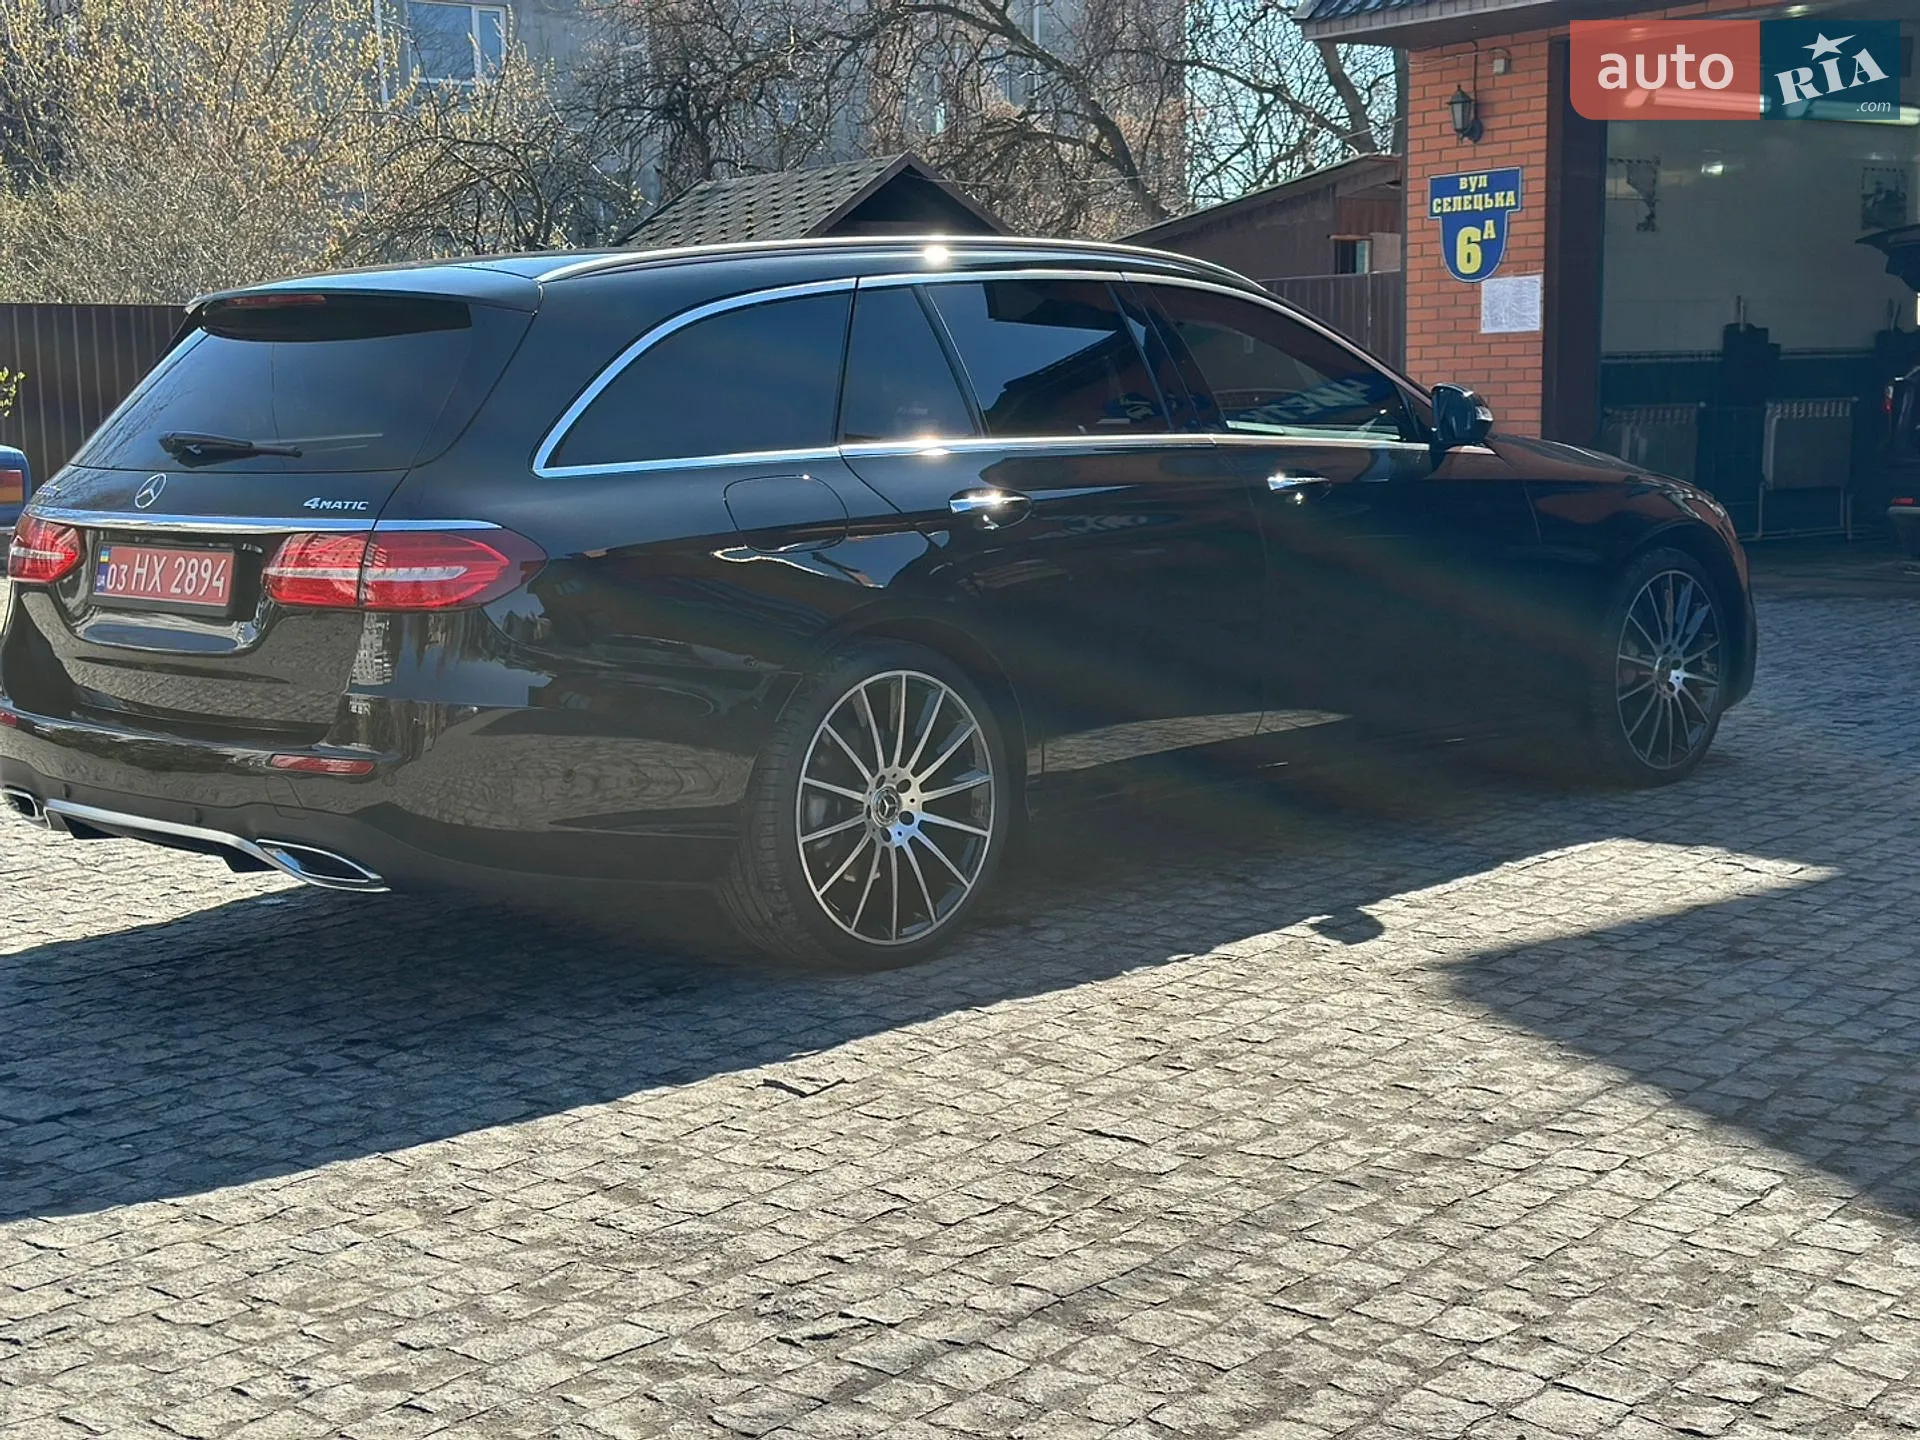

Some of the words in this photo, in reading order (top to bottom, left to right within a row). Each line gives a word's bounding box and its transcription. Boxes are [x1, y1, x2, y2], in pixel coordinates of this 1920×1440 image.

[1459, 174, 1488, 193] вул
[1432, 190, 1516, 214] СЕЛЕЦЬКА
[303, 497, 369, 511] 4MATIC
[106, 563, 128, 591] 03
[131, 552, 167, 593] HX
[170, 556, 227, 598] 2894
